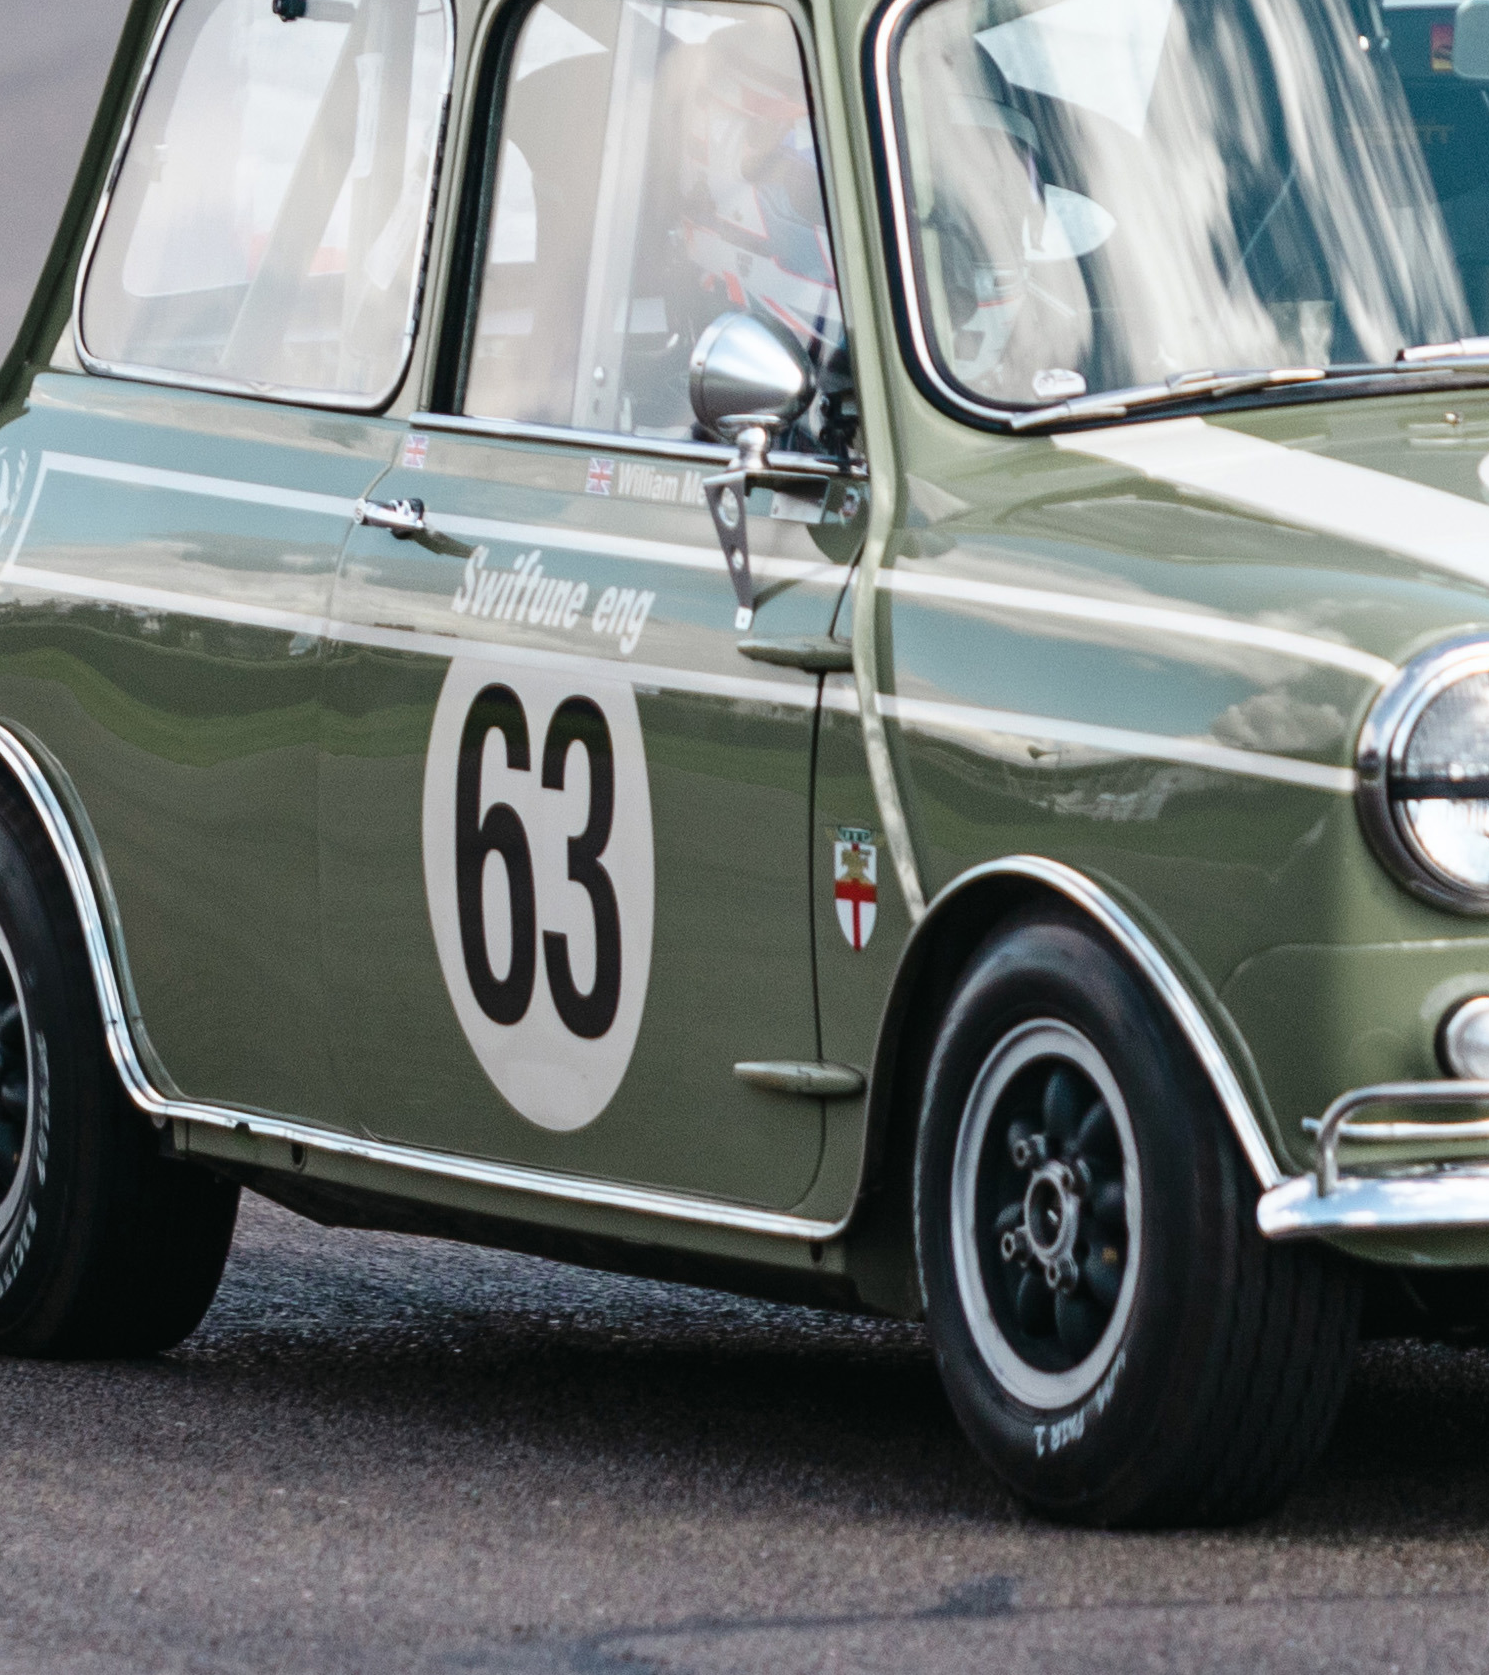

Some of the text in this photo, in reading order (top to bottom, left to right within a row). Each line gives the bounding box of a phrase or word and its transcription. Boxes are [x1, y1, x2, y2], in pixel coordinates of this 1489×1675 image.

[617, 462, 679, 502] William
[450, 544, 656, 655] Swiftune eng
[455, 681, 622, 1040] 63
